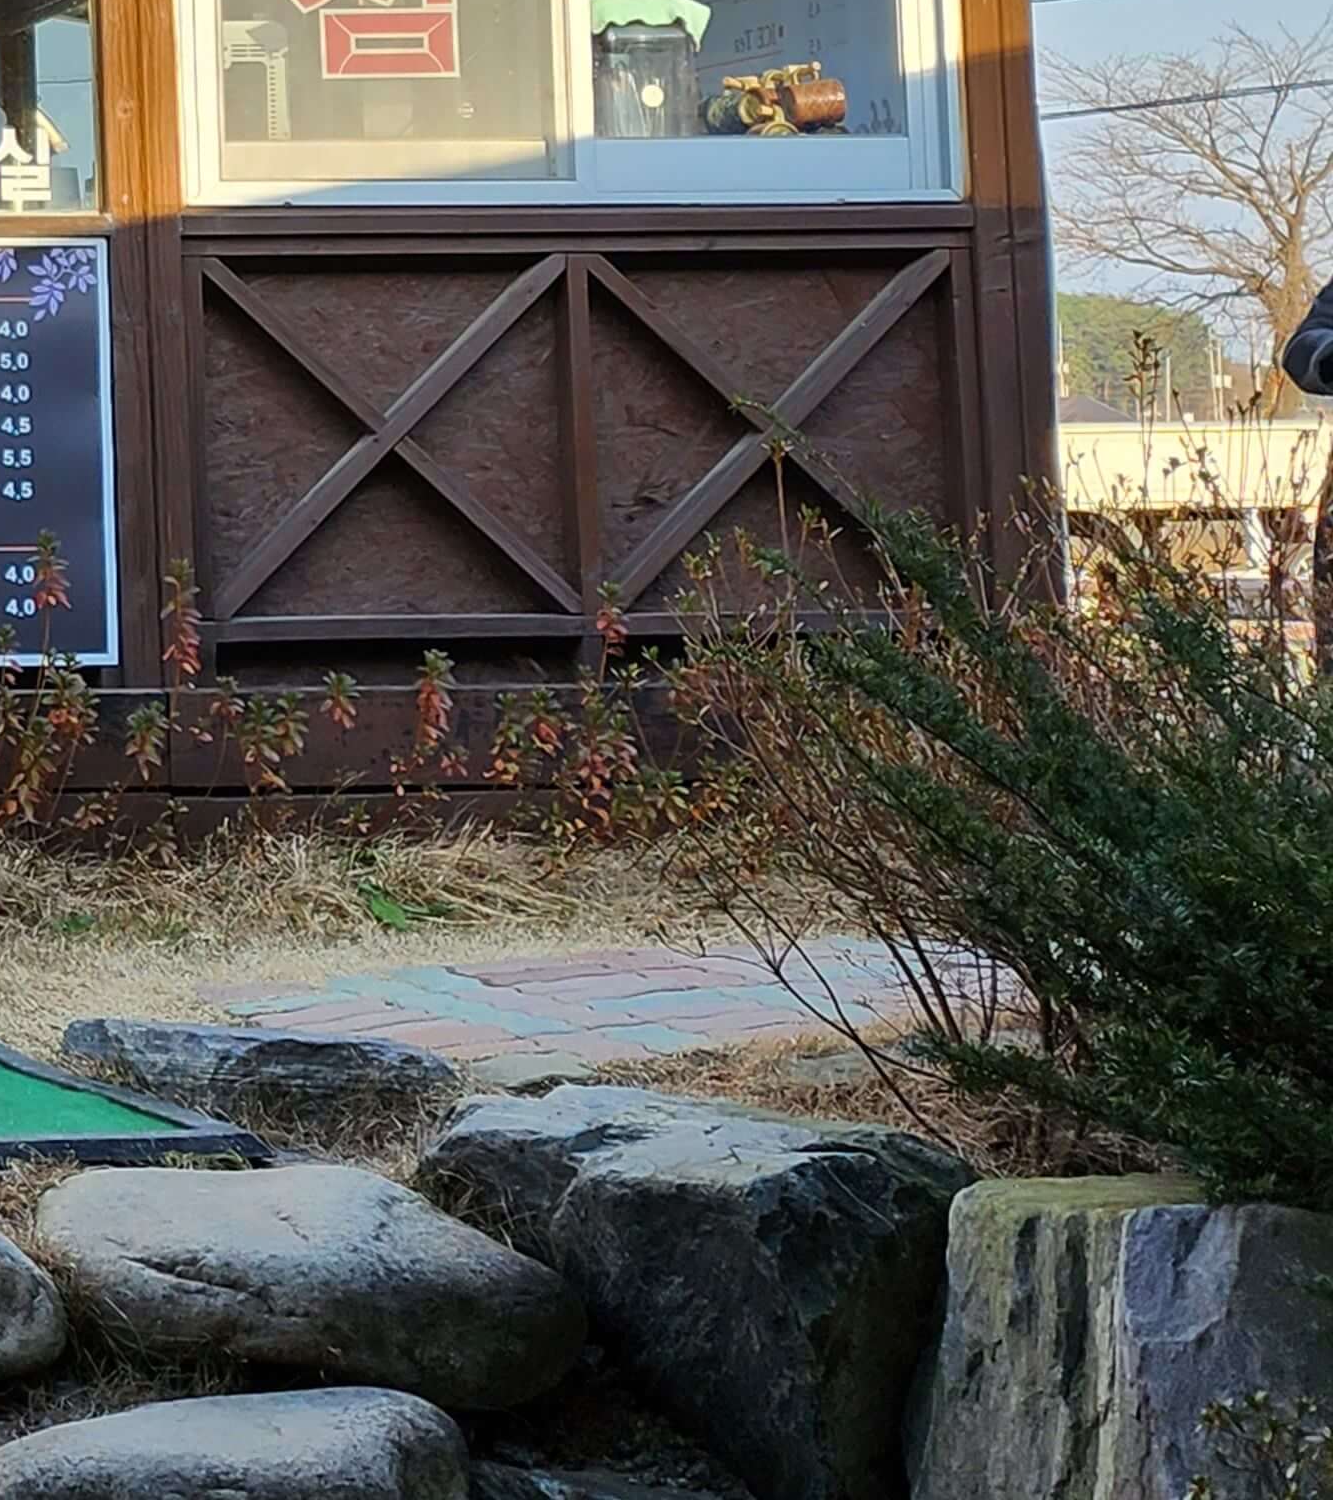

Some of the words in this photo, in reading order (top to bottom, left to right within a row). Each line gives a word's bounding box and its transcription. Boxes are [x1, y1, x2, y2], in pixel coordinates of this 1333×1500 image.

[0, 352, 30, 372] 5.0
[0, 384, 31, 404] 4.0
[0, 416, 32, 436] 4.5
[1, 449, 33, 468] 5.5
[2, 481, 34, 501] 4.5
[4, 565, 36, 586] 4.0
[5, 598, 37, 618] 4.0
